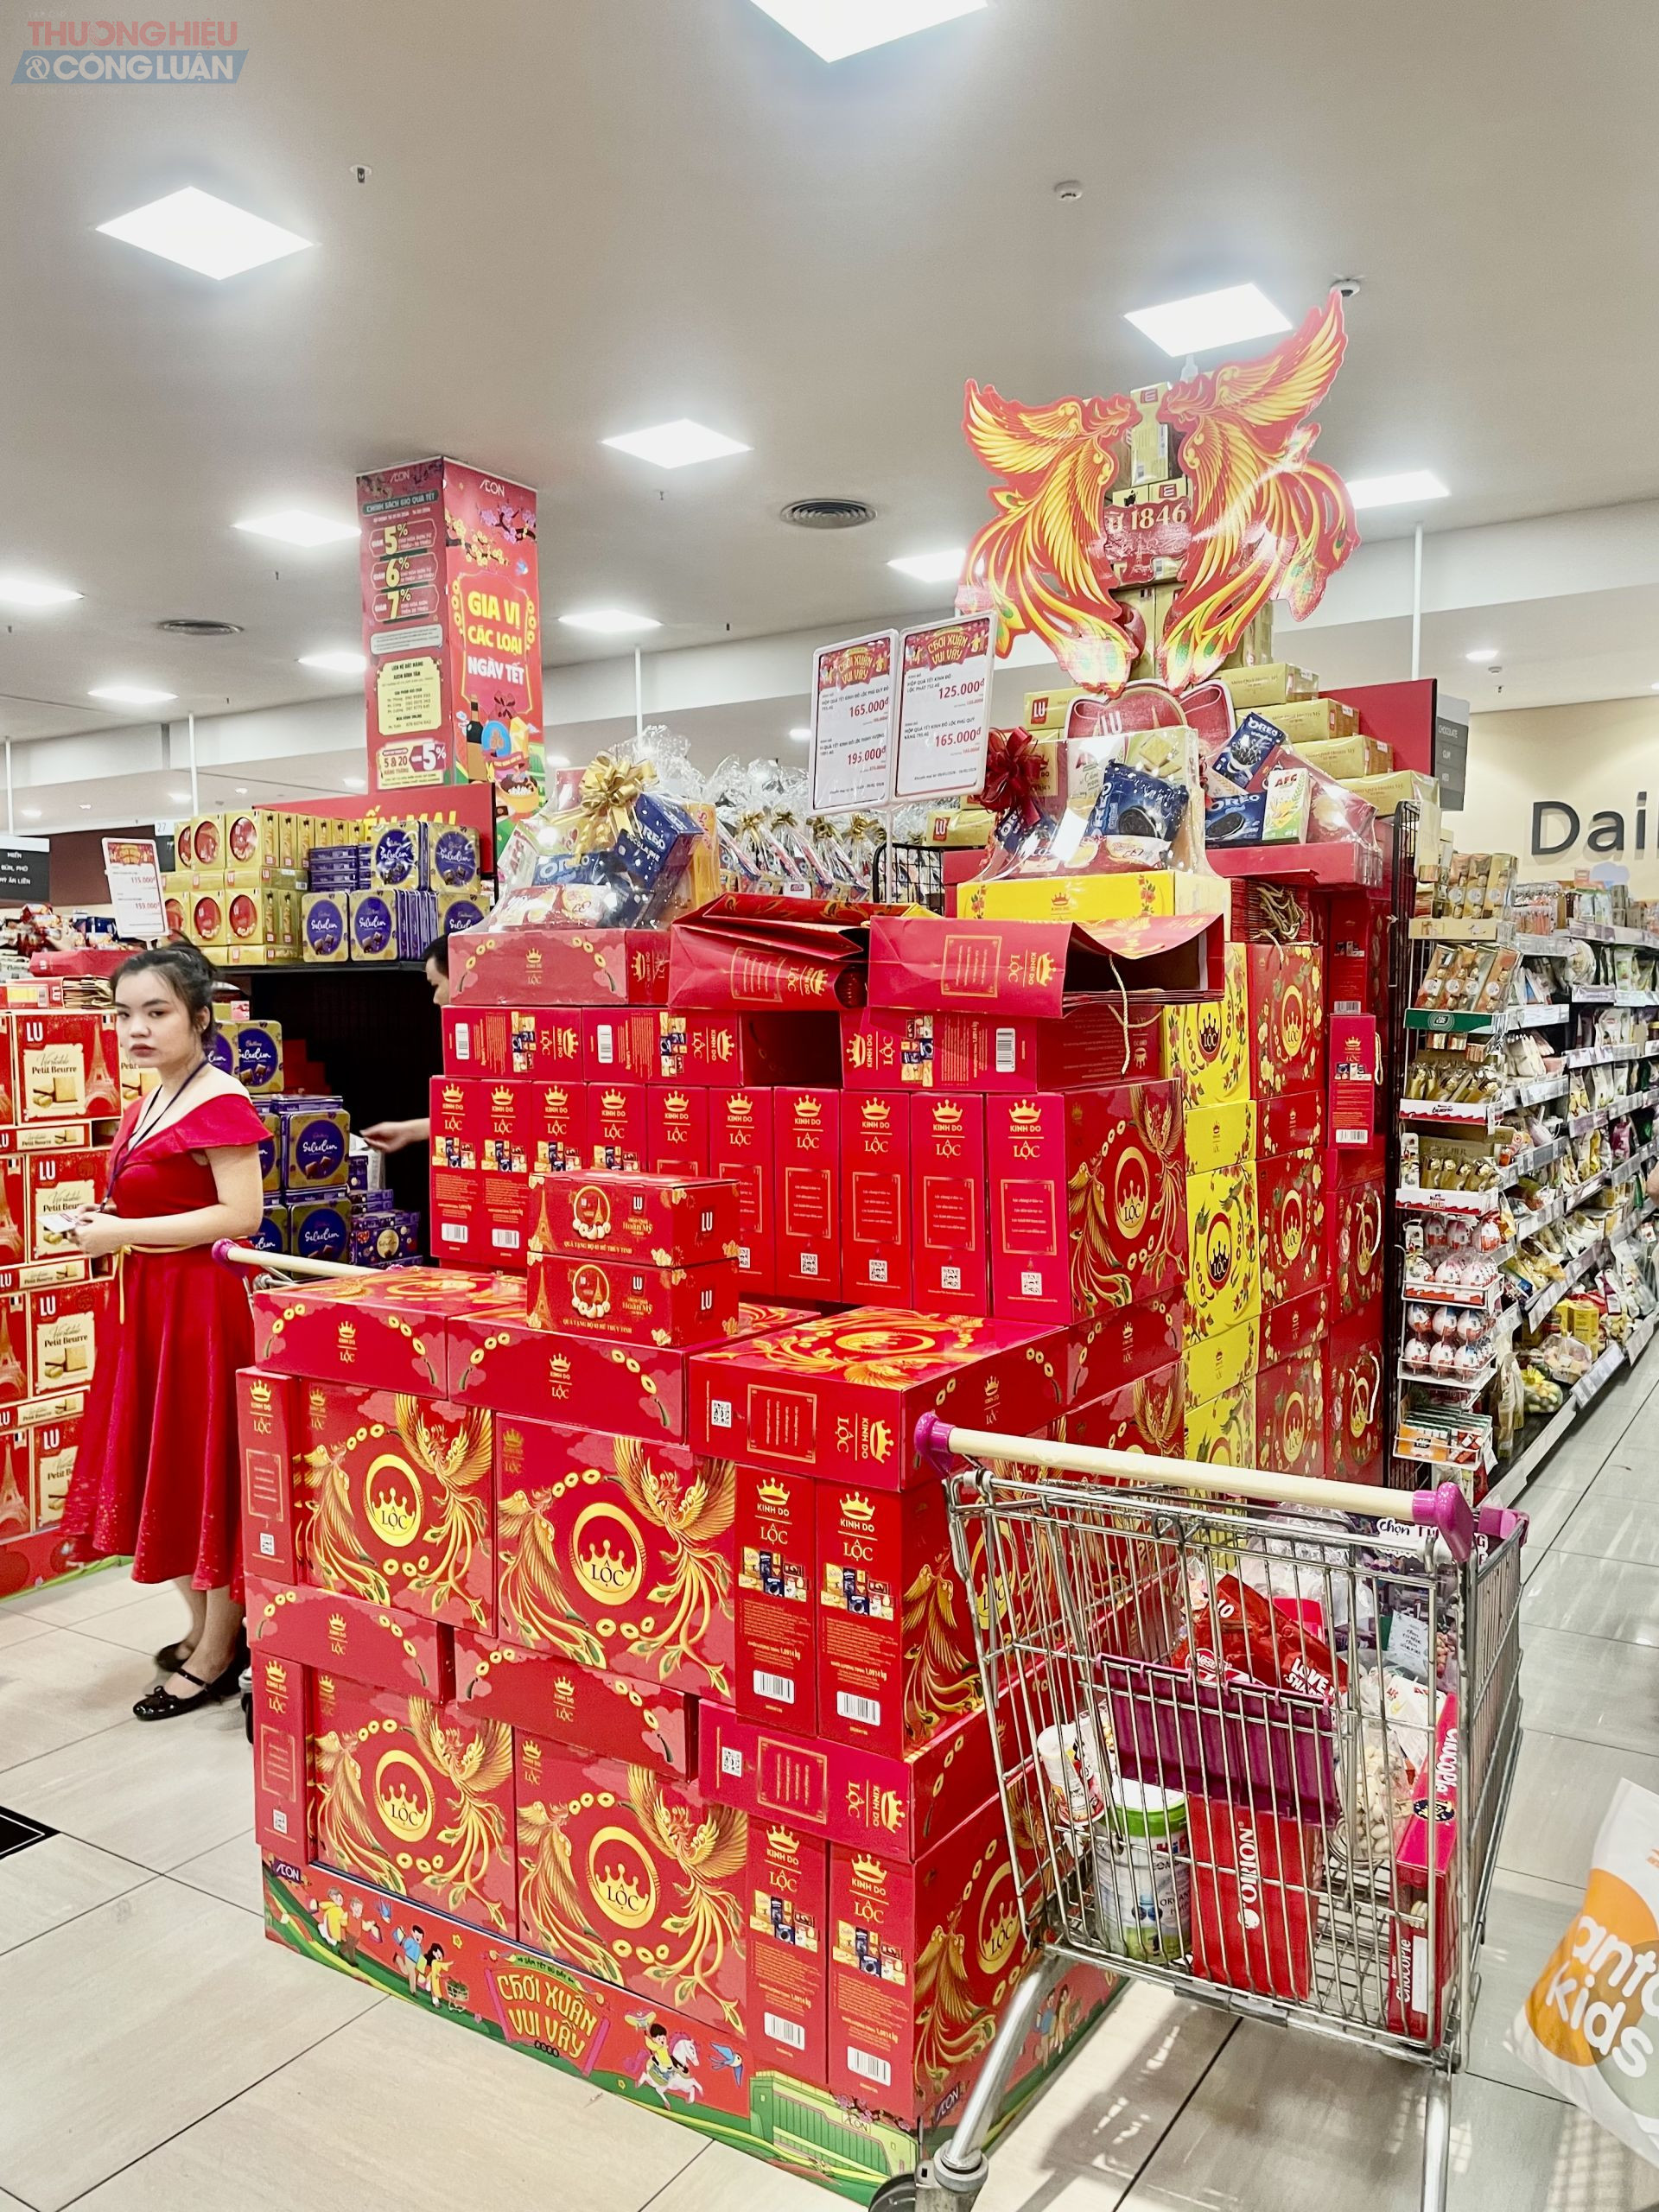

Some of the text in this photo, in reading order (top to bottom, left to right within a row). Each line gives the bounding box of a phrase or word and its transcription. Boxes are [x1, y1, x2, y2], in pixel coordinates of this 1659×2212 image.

[1131, 502, 1187, 531] 1846
[467, 590, 501, 622] GIA
[504, 599, 521, 631] VỊ
[467, 624, 494, 648] CÁC
[496, 632, 523, 656] LOẠI
[947, 633, 969, 650] XUÂN
[931, 651, 946, 665] VUI
[467, 656, 525, 685] NGÀY TẾT
[939, 677, 985, 700] 125.000đ
[849, 696, 890, 718] 165.000đ
[1033, 702, 1046, 718] LU
[1101, 710, 1123, 734] LU
[1248, 716, 1278, 736] OREO
[935, 727, 982, 747] 165.000đ
[1211, 793, 1261, 812] OREO
[1531, 791, 1659, 855] Dai
[1007, 954, 1024, 983] LỘC
[26, 1021, 44, 1043] LU
[867, 1033, 873, 1045] DO
[540, 1029, 553, 1057] LỘC
[692, 1032, 705, 1059] LỘC
[879, 1036, 896, 1065] LỘC
[32, 1065, 77, 1075] Petit Beurre
[444, 1116, 463, 1134] LỘC
[494, 1119, 513, 1135] LỘC
[547, 1120, 567, 1137] LỘC
[604, 1122, 625, 1141] LỘC
[667, 1126, 688, 1144] LỘC
[729, 1128, 752, 1147] LỘC
[797, 1132, 820, 1151] LỘC
[865, 1136, 889, 1154] LỘC
[936, 1140, 962, 1159] LỘC
[1014, 1141, 1041, 1160] LỘC
[39, 1160, 56, 1181] LU
[632, 1196, 643, 1211] LU
[702, 1212, 714, 1233] LU
[632, 1276, 643, 1290] LU
[40, 1296, 56, 1316] LU
[702, 1290, 713, 1311] LU
[44, 1333, 88, 1348] Petit Beurre
[552, 1384, 569, 1400] LỘC
[43, 1428, 60, 1450] LU
[835, 1416, 855, 1453] LỘC
[861, 1444, 868, 1459] DO
[381, 1505, 409, 1531] LỘC
[757, 1503, 790, 1517] KINH DO
[760, 1522, 788, 1546] LỘC
[840, 1518, 875, 1533] KINH DO
[1380, 1519, 1411, 1537] Chọn
[843, 1539, 874, 1562] LỘC
[591, 1560, 625, 1587] LỘC
[1291, 1657, 1329, 1694] LOVE
[391, 1801, 419, 1827] LỘC
[766, 1847, 799, 1866] KINH DO
[769, 1871, 798, 1893] LỘC
[851, 1877, 887, 1897] KINH DO
[606, 1881, 639, 1912] LỘC
[854, 1900, 885, 1924] LỘC
[544, 1980, 598, 2037] XUÂN
[508, 2008, 541, 2038] VUI
[1545, 1961, 1654, 2079] kids
